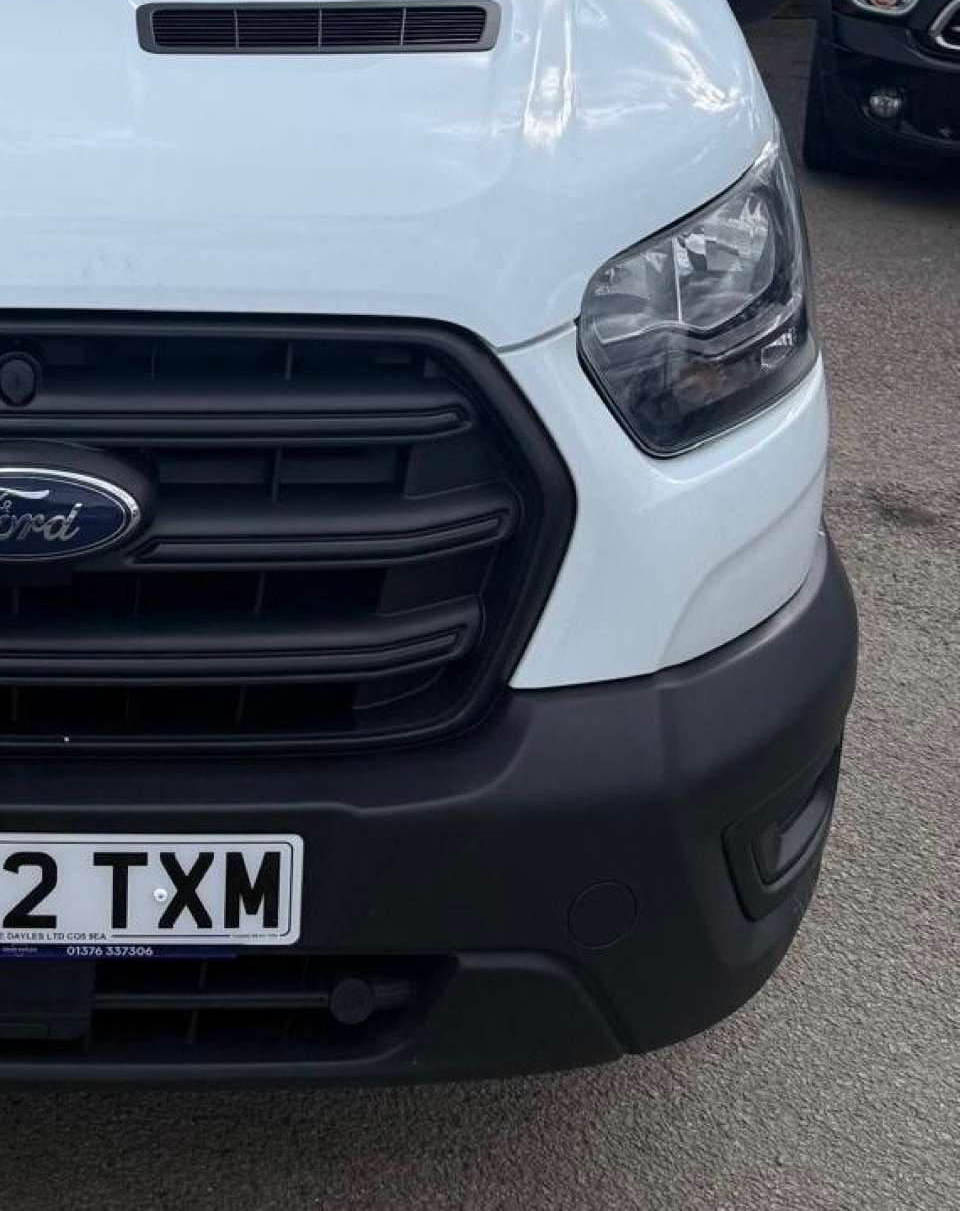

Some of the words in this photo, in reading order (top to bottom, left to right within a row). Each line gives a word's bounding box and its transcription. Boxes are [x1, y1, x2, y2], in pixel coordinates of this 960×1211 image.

[93, 851, 281, 929] TXM
[46, 932, 65, 941] LTD
[66, 945, 103, 956] 01376
[105, 945, 154, 956] 337306
